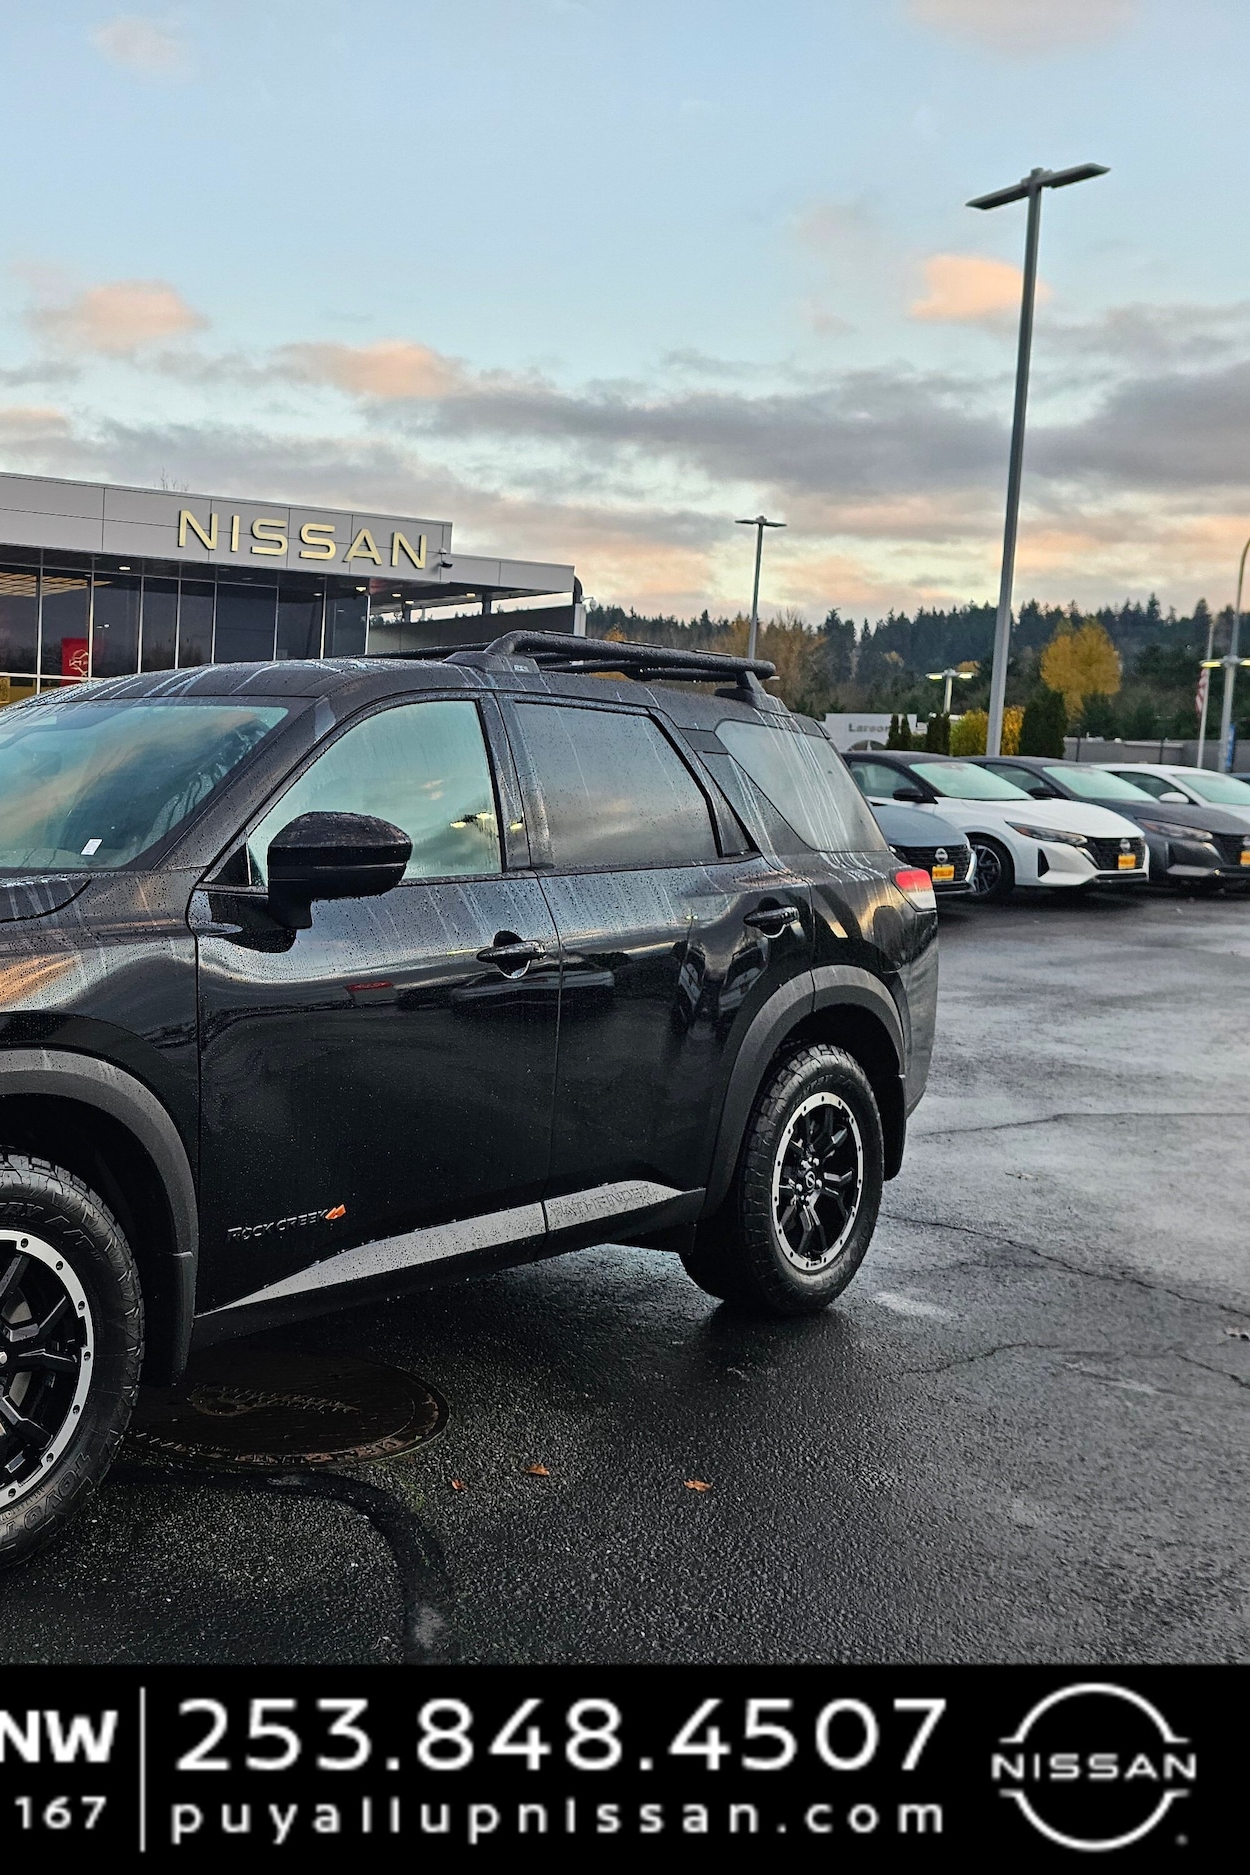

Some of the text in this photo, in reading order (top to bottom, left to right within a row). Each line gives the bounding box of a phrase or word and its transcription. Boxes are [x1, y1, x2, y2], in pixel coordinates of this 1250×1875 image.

[178, 509, 428, 569] NISSAN
[276, 1209, 328, 1231] CREEK
[23, 1452, 91, 1533] TOYO
